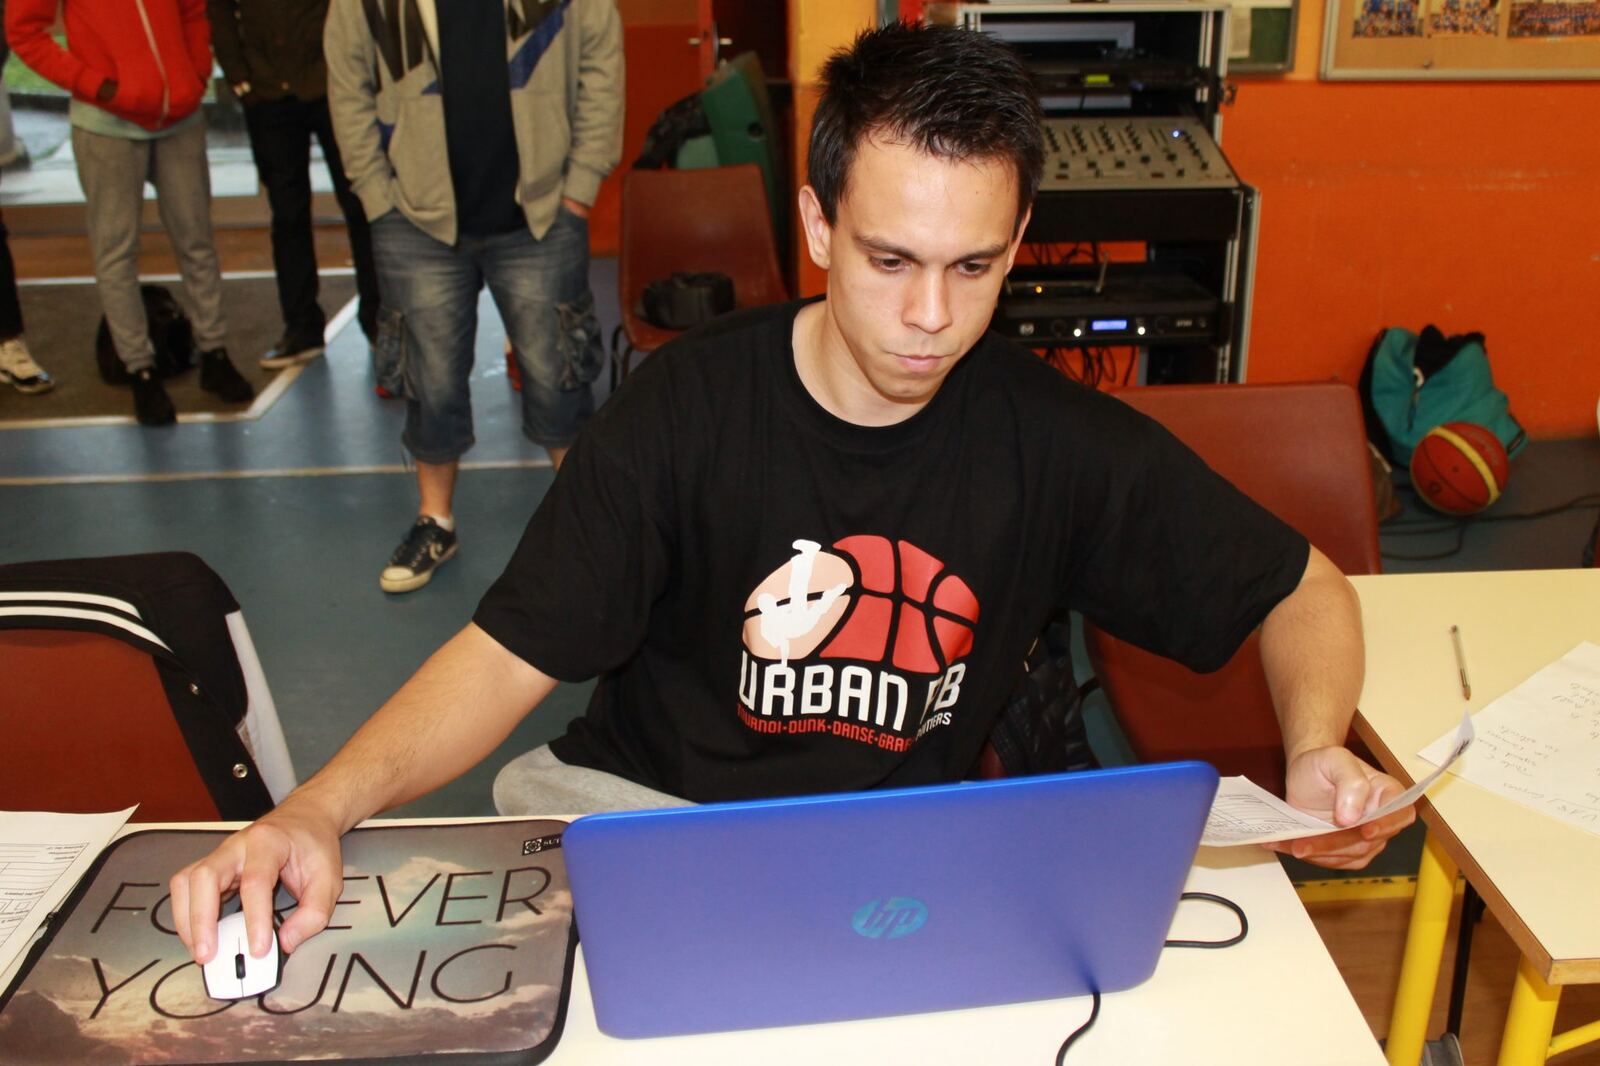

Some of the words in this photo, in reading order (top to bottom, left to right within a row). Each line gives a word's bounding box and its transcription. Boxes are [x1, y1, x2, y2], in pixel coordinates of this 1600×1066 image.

[739, 650, 908, 731] URBAN
[788, 719, 826, 734] DUNK
[832, 720, 876, 744] DANSE
[91, 867, 552, 934] FEVER
[854, 896, 926, 940] hp
[89, 943, 518, 1020] YOUNG
